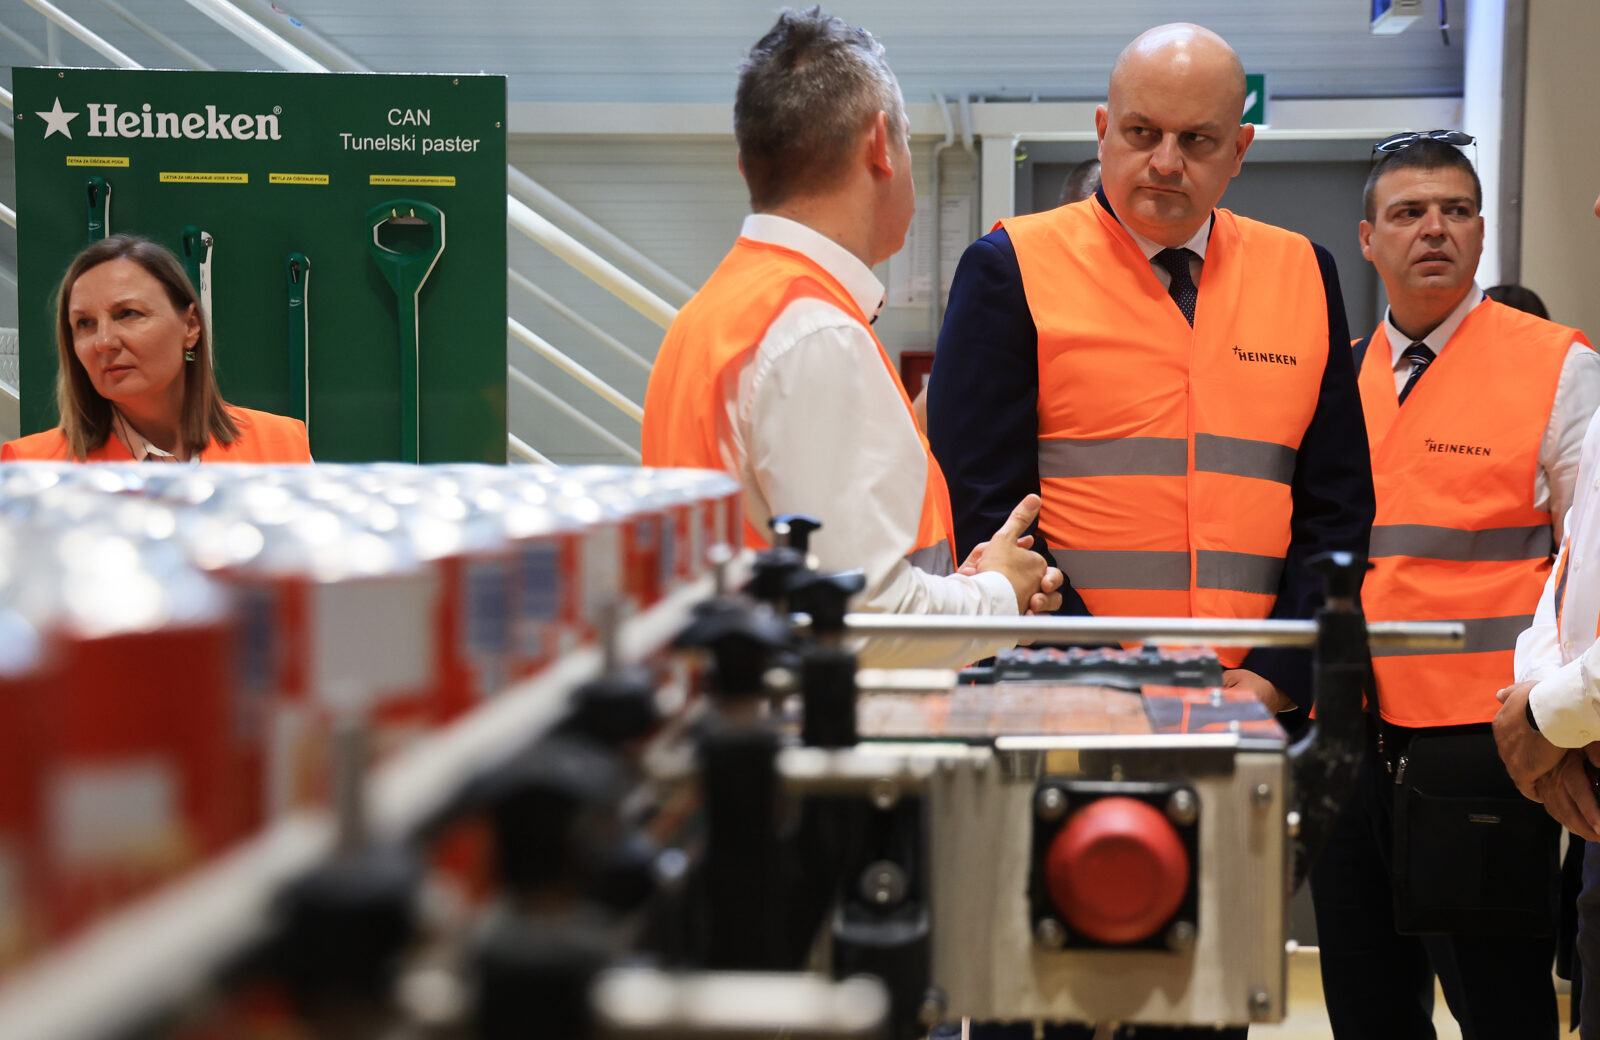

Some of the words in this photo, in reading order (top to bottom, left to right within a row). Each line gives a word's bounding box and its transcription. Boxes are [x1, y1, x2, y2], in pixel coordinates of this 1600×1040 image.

[387, 108, 431, 126] CAN
[339, 132, 416, 151] Tunelski
[422, 136, 480, 155] paster
[1238, 351, 1297, 366] HEINEKEN
[1428, 443, 1491, 456] HEINEKEN
